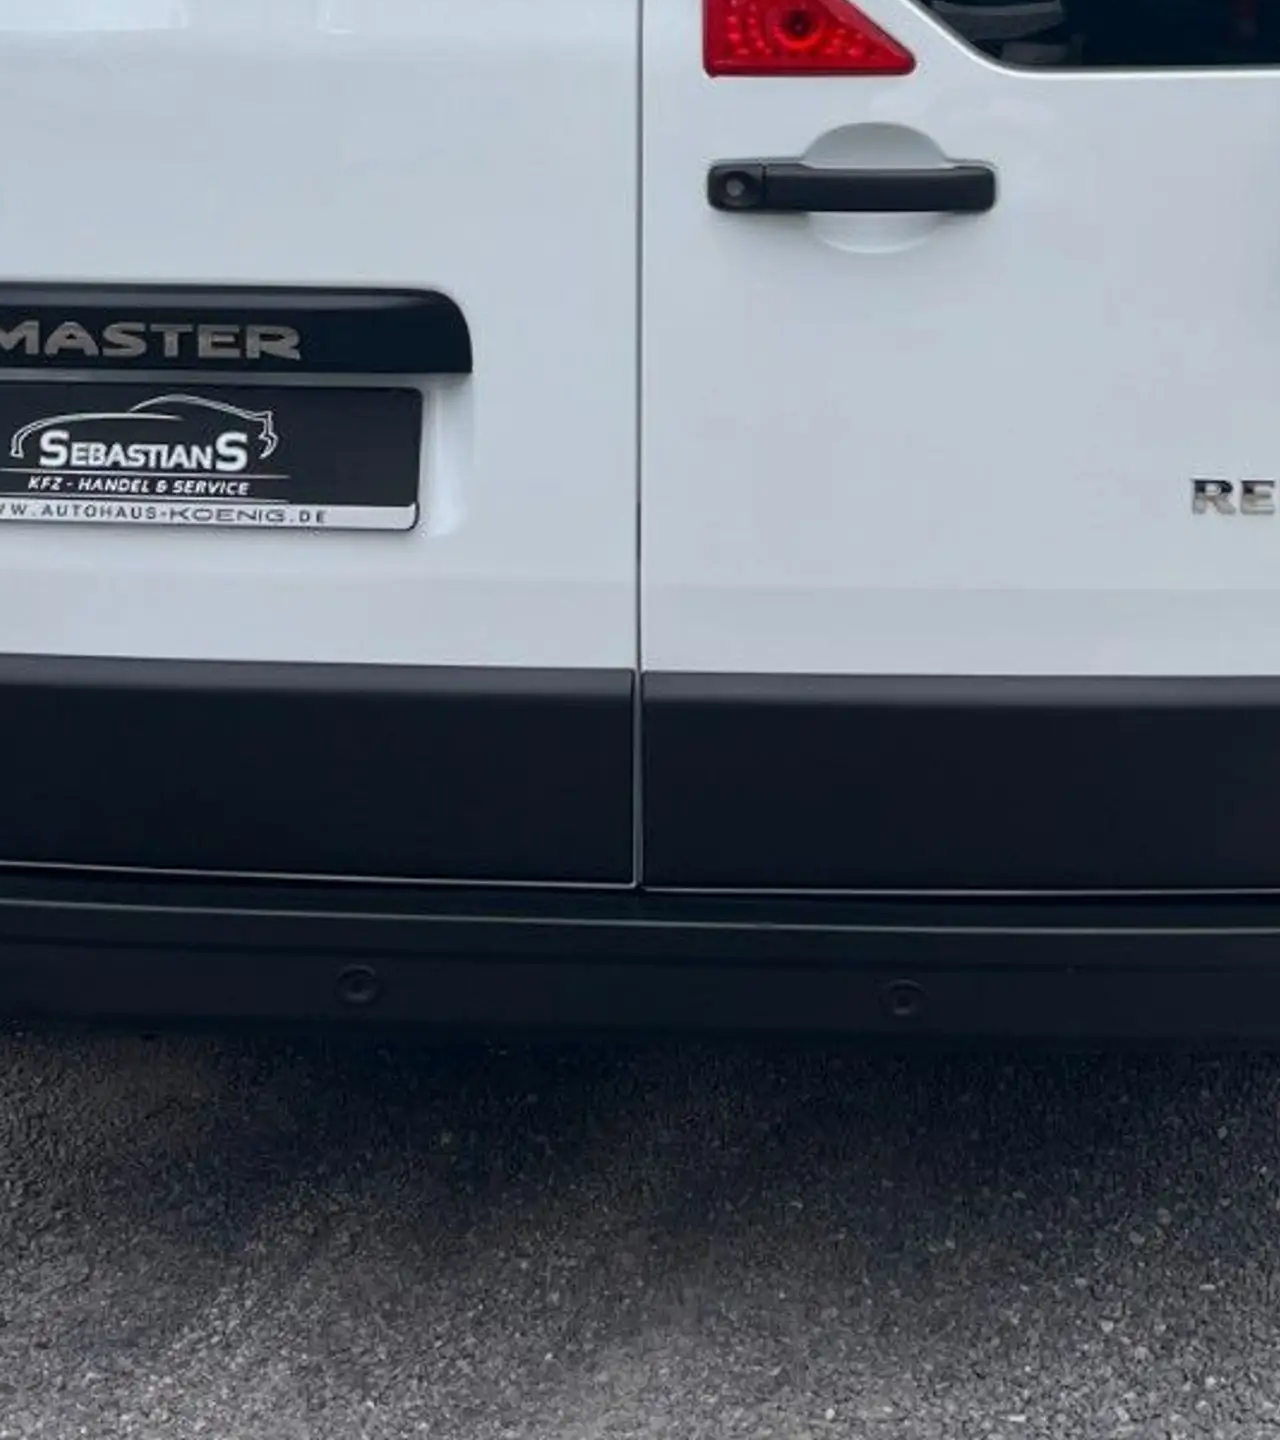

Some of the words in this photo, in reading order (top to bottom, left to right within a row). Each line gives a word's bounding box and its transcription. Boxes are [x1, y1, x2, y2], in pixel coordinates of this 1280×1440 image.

[39, 429, 249, 471] SEBASTIANS
[28, 475, 62, 491] KFZ
[78, 477, 150, 494] HANDEL
[156, 479, 167, 494] &
[172, 480, 251, 496] SERVICE
